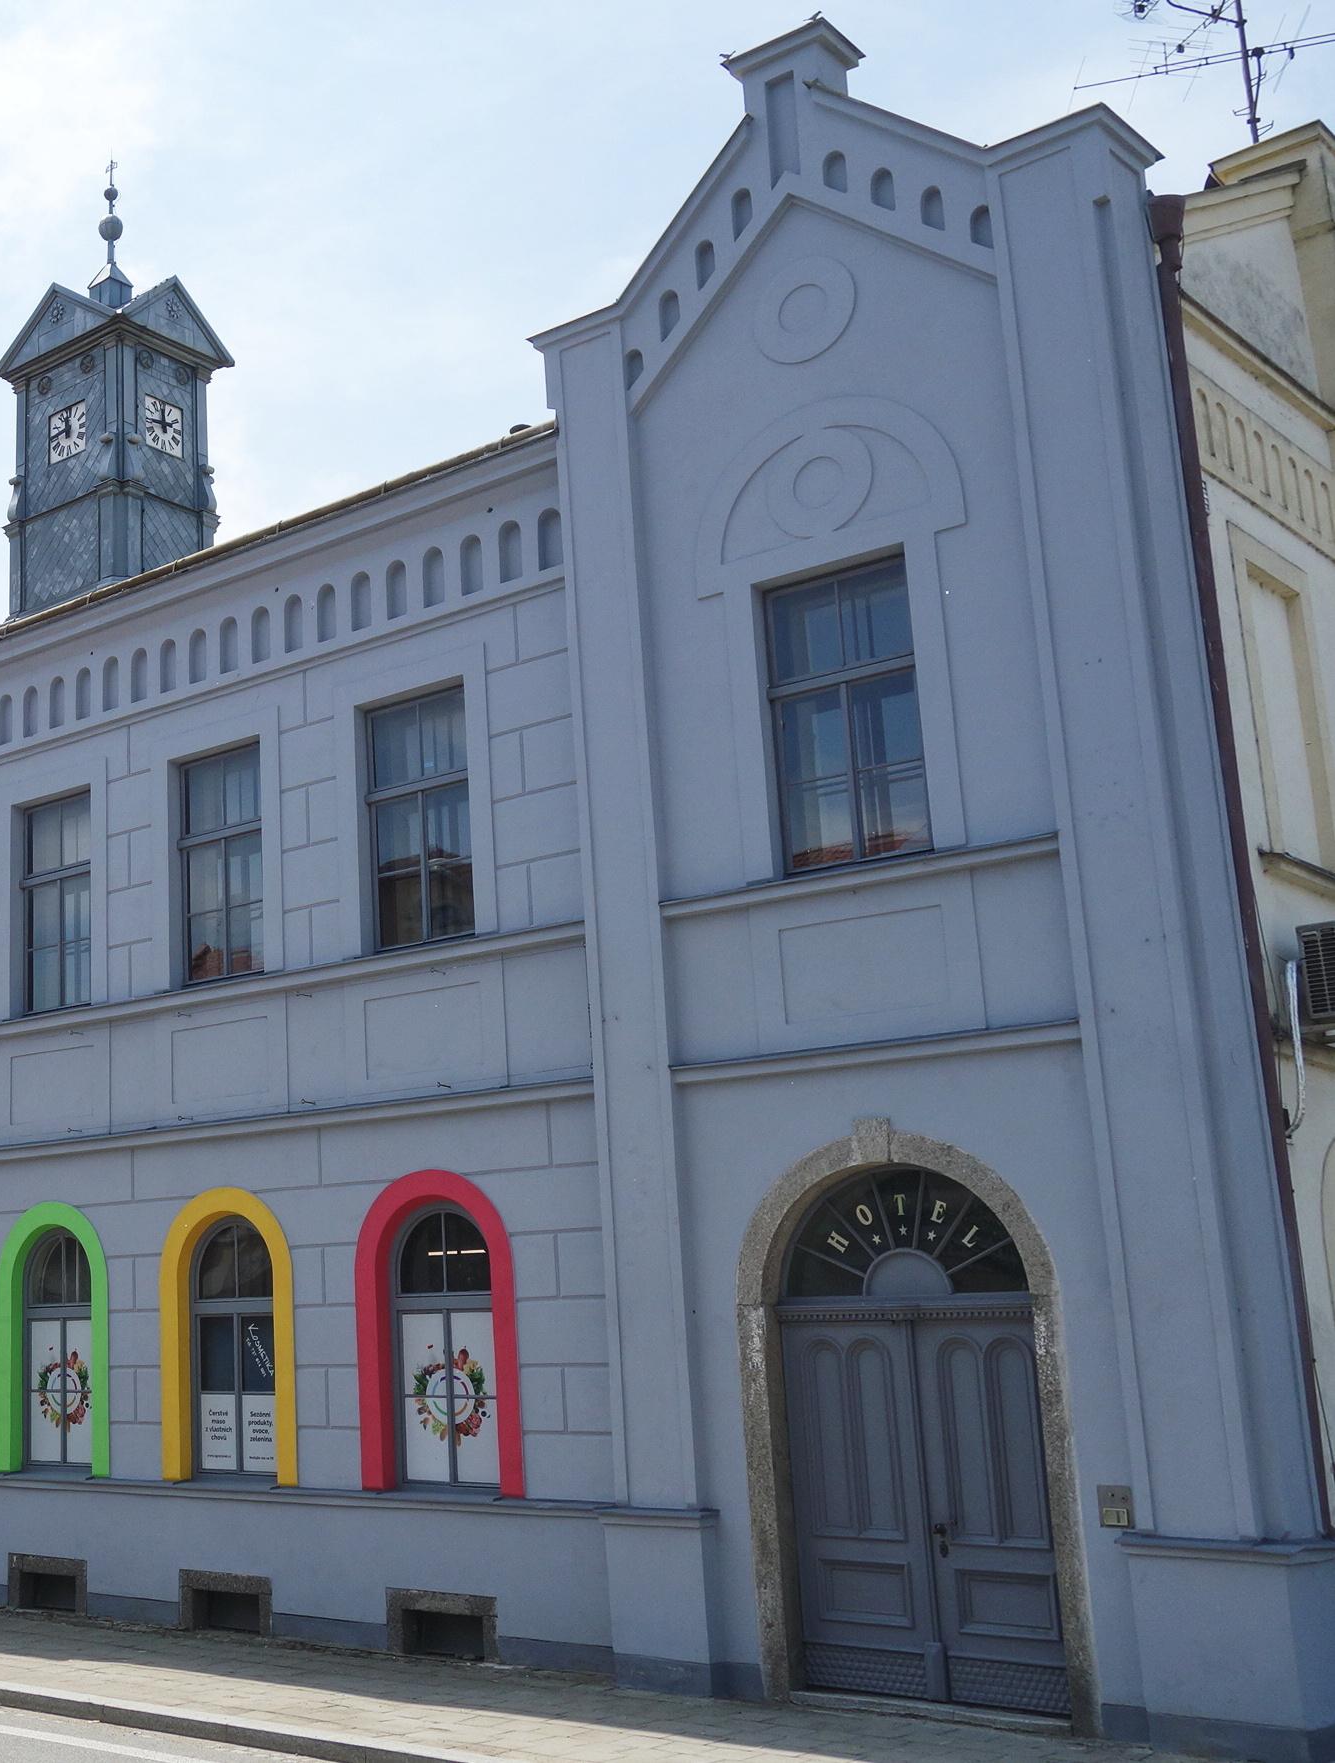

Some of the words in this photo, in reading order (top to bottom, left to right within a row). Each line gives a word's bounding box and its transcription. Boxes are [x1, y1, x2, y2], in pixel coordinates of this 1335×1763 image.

[827, 1194, 979, 1254] HOTEL
[248, 1323, 274, 1377] KOSMETIKA
[208, 1408, 228, 1416] Čerstvé
